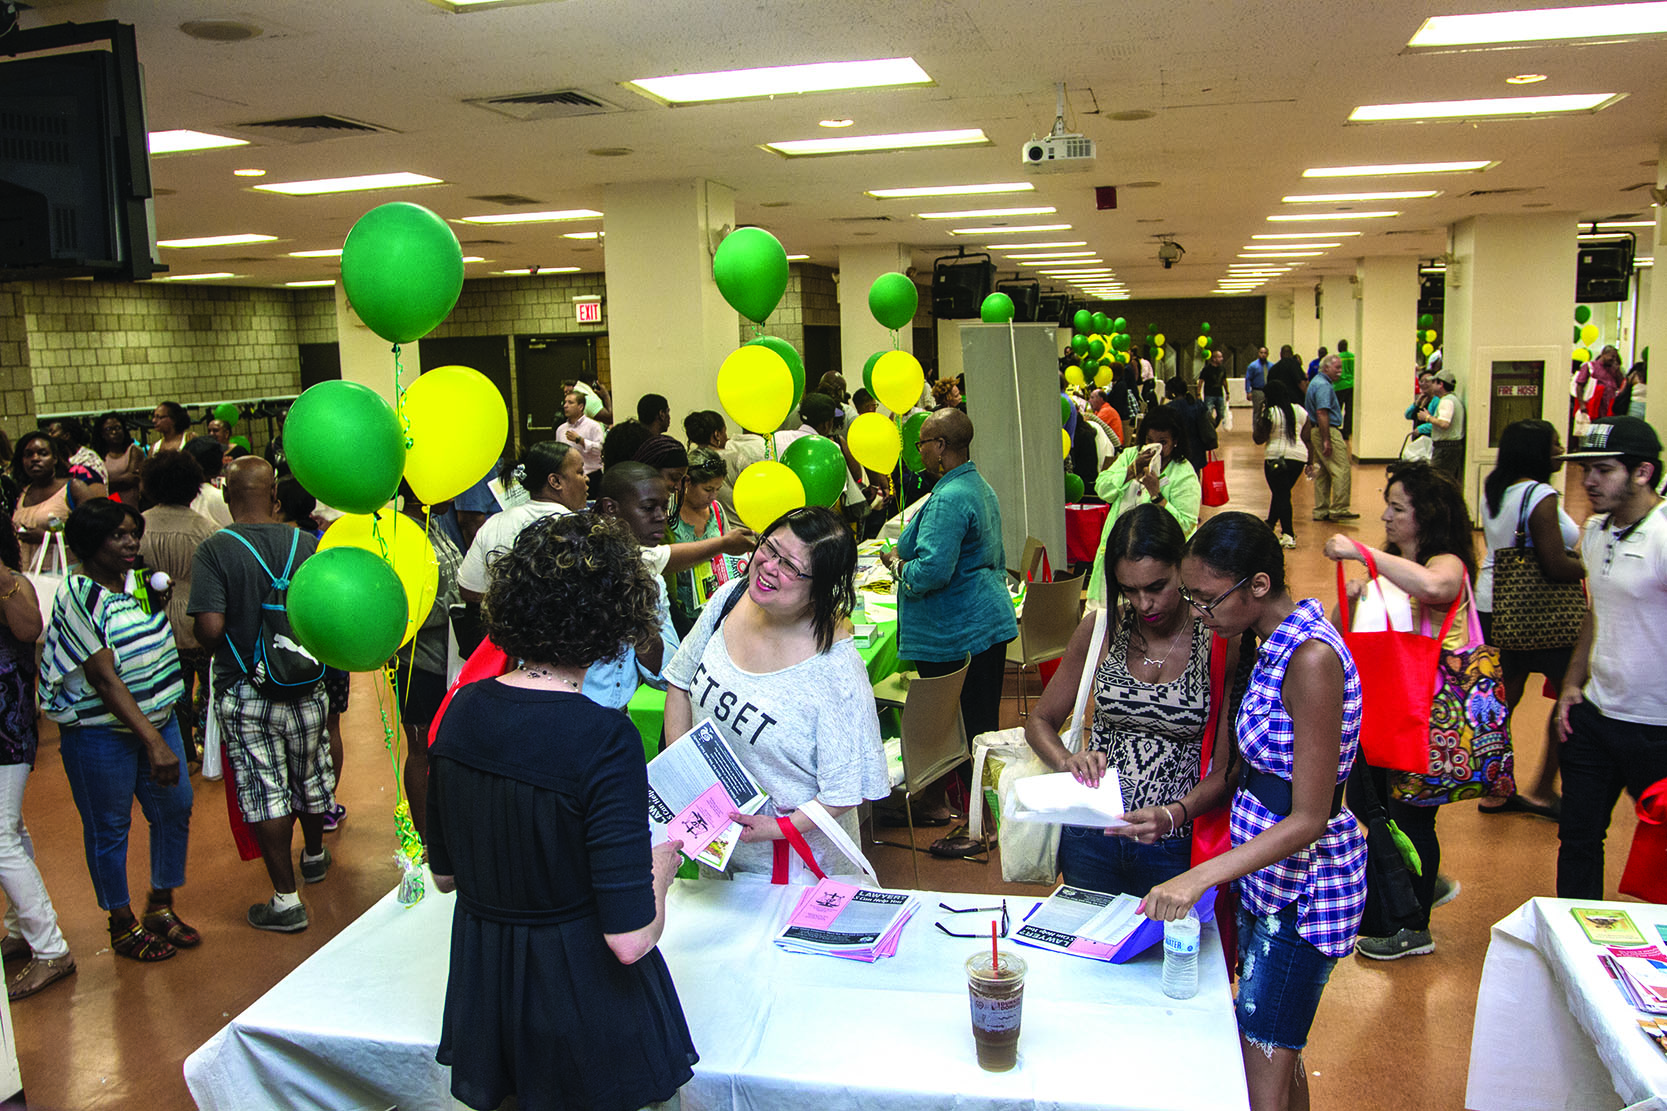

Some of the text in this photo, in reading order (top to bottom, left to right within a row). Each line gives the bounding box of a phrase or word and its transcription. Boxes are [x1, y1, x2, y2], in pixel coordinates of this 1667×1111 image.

[580, 304, 598, 320] EXIT
[1498, 386, 1536, 395] FIRE HOSE
[859, 891, 907, 900] LAWYER?
[1019, 930, 1070, 946] LAWYER?
